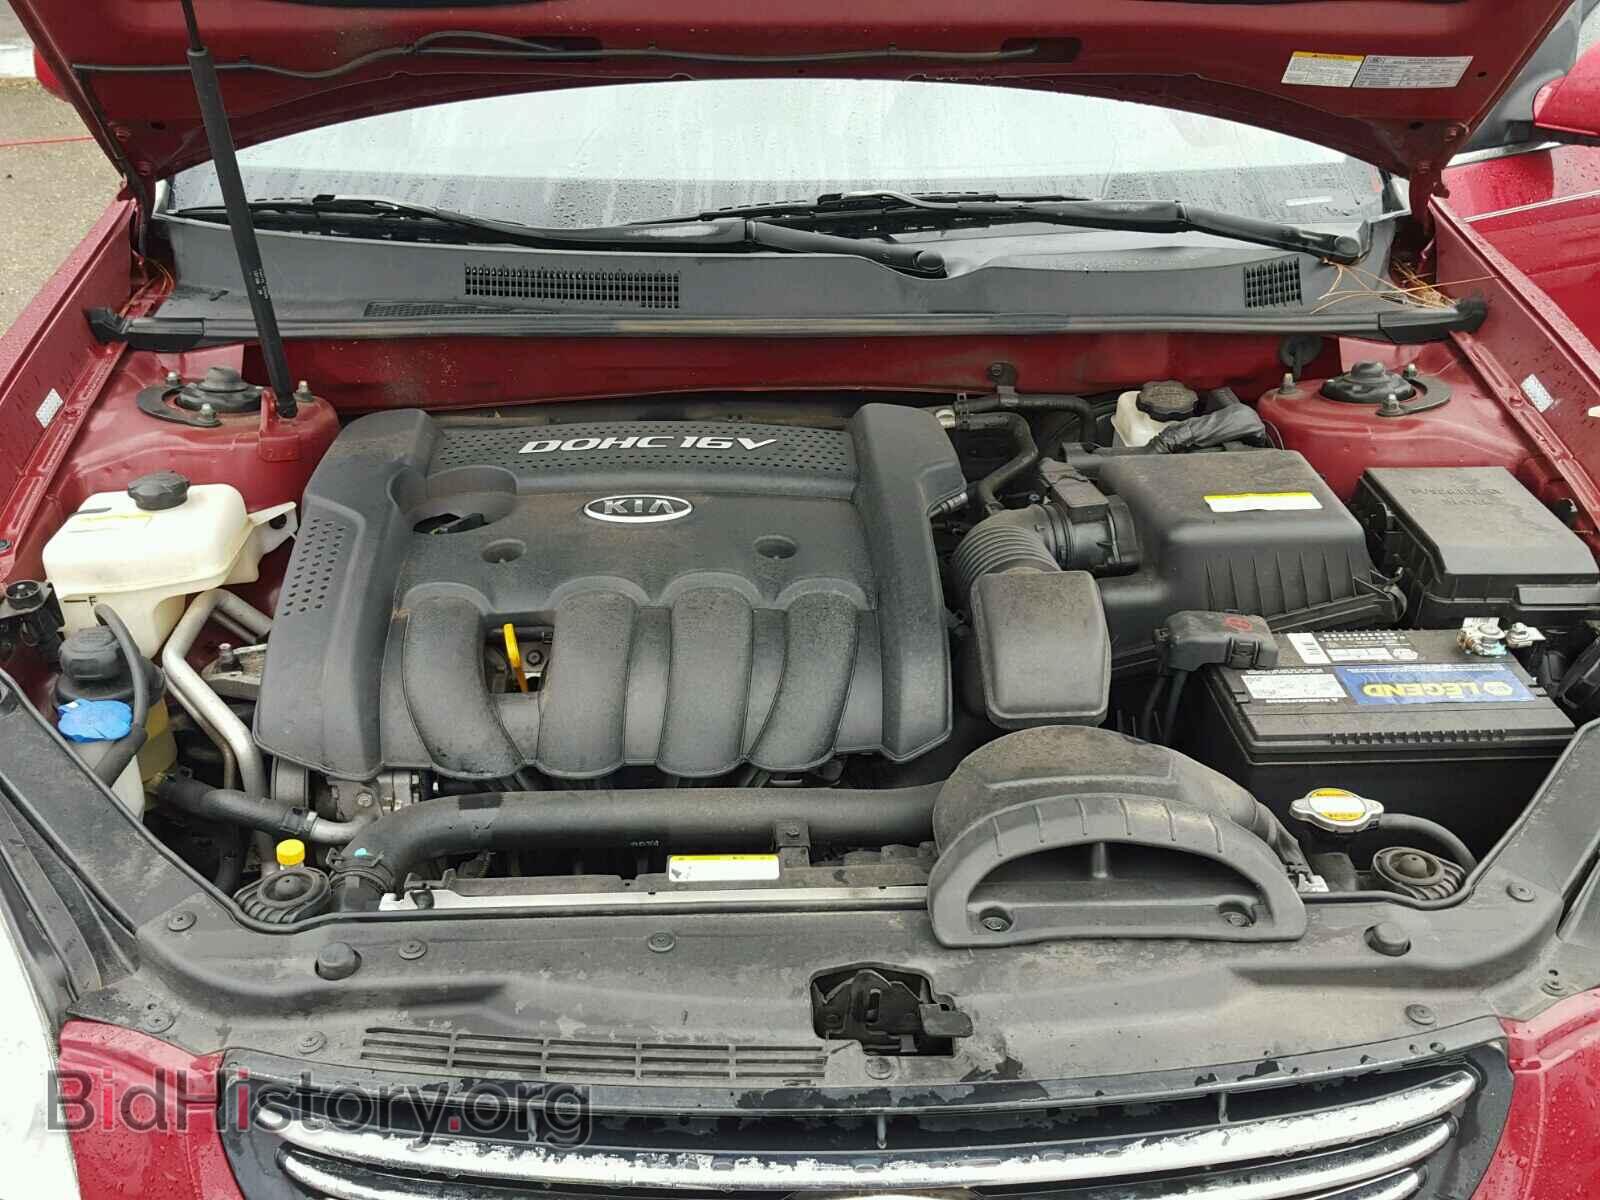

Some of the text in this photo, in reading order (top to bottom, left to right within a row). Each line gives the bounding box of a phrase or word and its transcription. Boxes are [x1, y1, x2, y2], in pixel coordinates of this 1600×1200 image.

[518, 435, 778, 454] DOHC 16V
[603, 499, 675, 514] KIA
[1362, 681, 1479, 698] LEGEND
